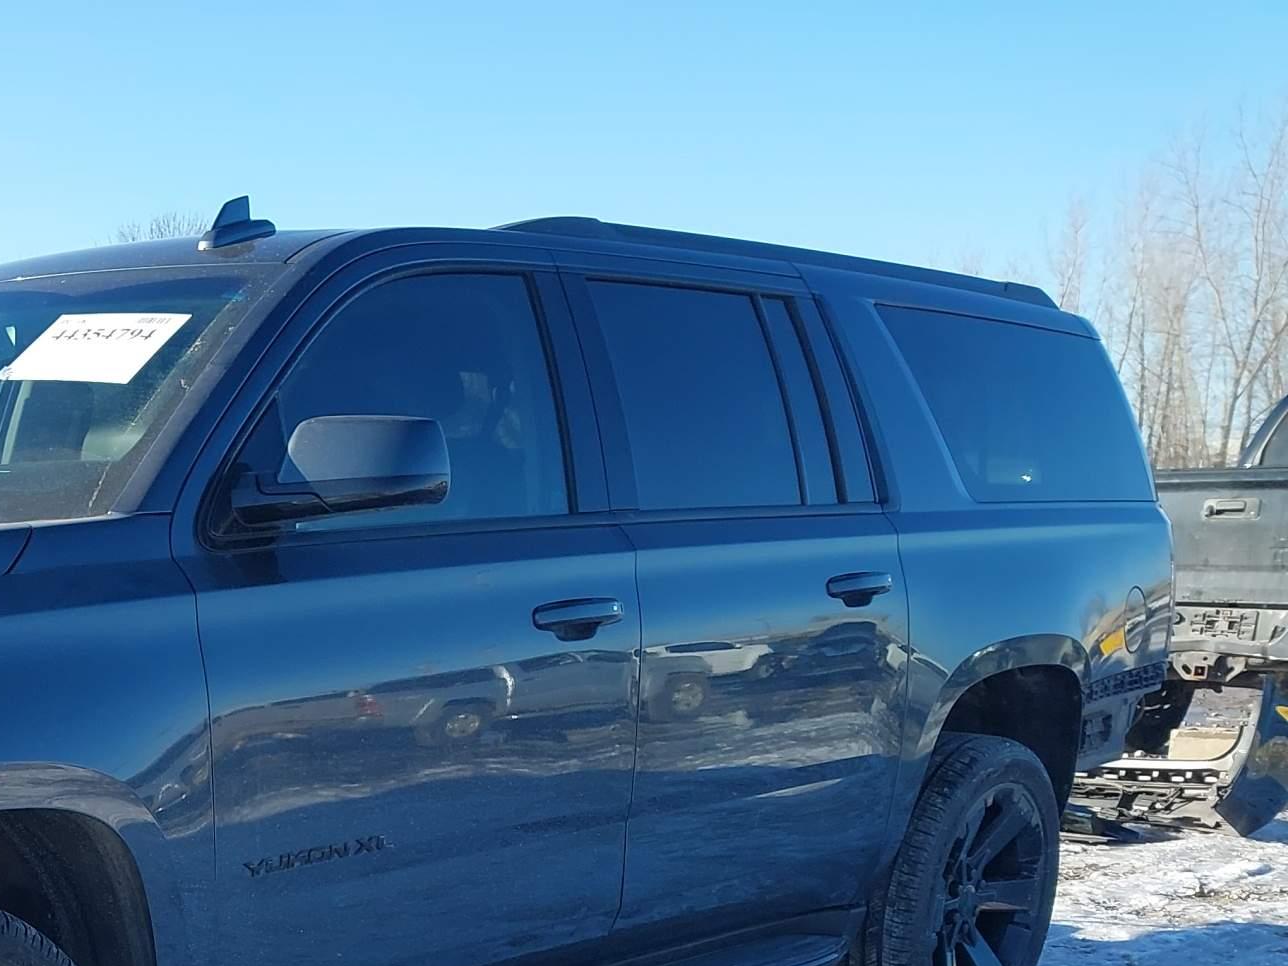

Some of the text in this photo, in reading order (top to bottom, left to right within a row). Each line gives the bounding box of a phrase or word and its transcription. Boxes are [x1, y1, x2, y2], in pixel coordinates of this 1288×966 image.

[52, 328, 157, 341] 44354794
[242, 833, 395, 878] YUKON XL
